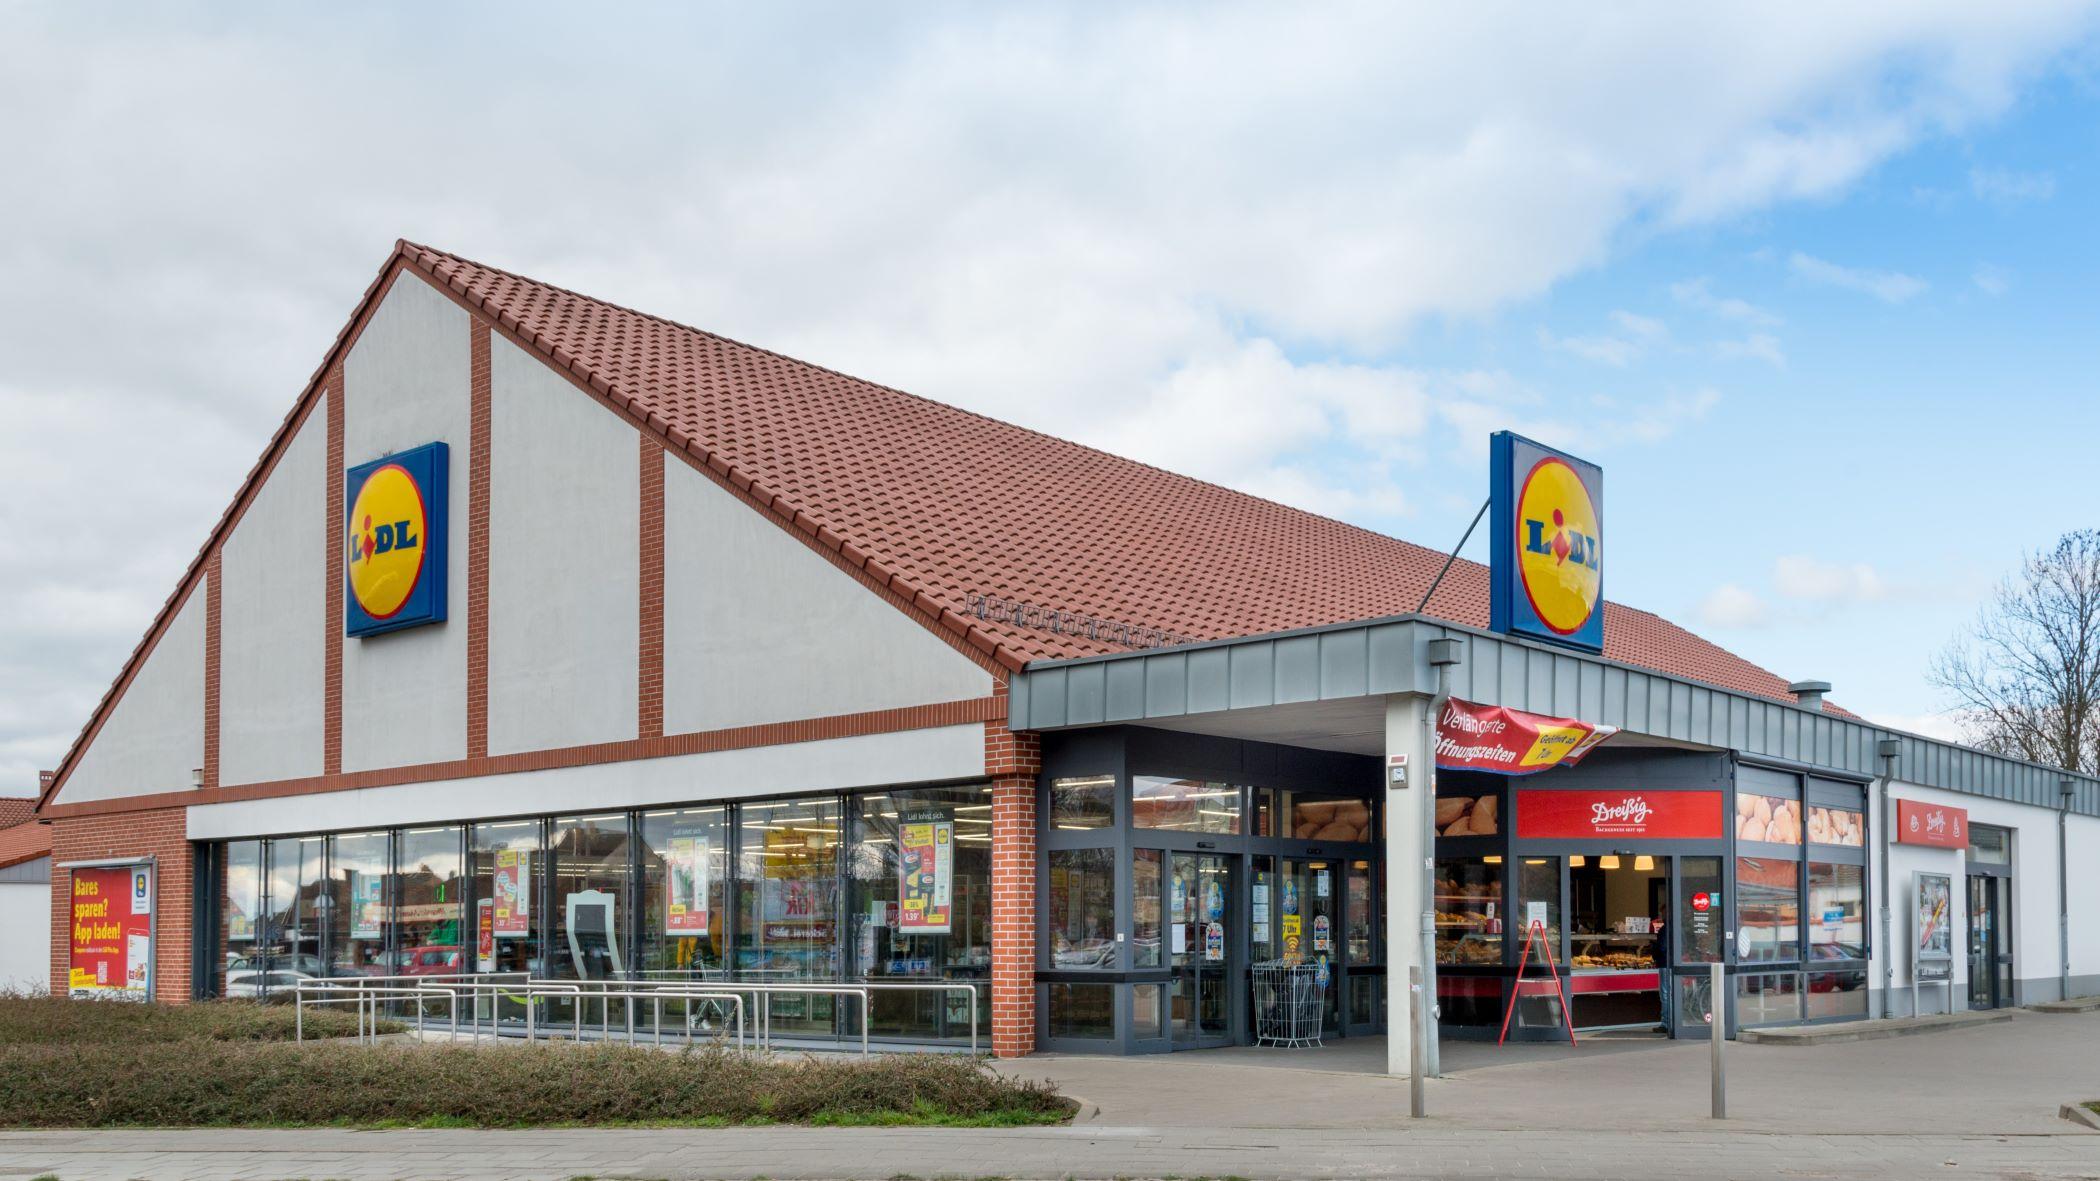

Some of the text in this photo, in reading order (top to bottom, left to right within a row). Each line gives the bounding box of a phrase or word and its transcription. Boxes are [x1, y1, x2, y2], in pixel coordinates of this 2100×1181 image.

[1435, 731, 1517, 763] Öffnungszeiten
[1591, 796, 1653, 824] Dreißig
[75, 878, 98, 896] Bares
[75, 898, 108, 922] sparen?
[74, 921, 121, 944] App laden!
